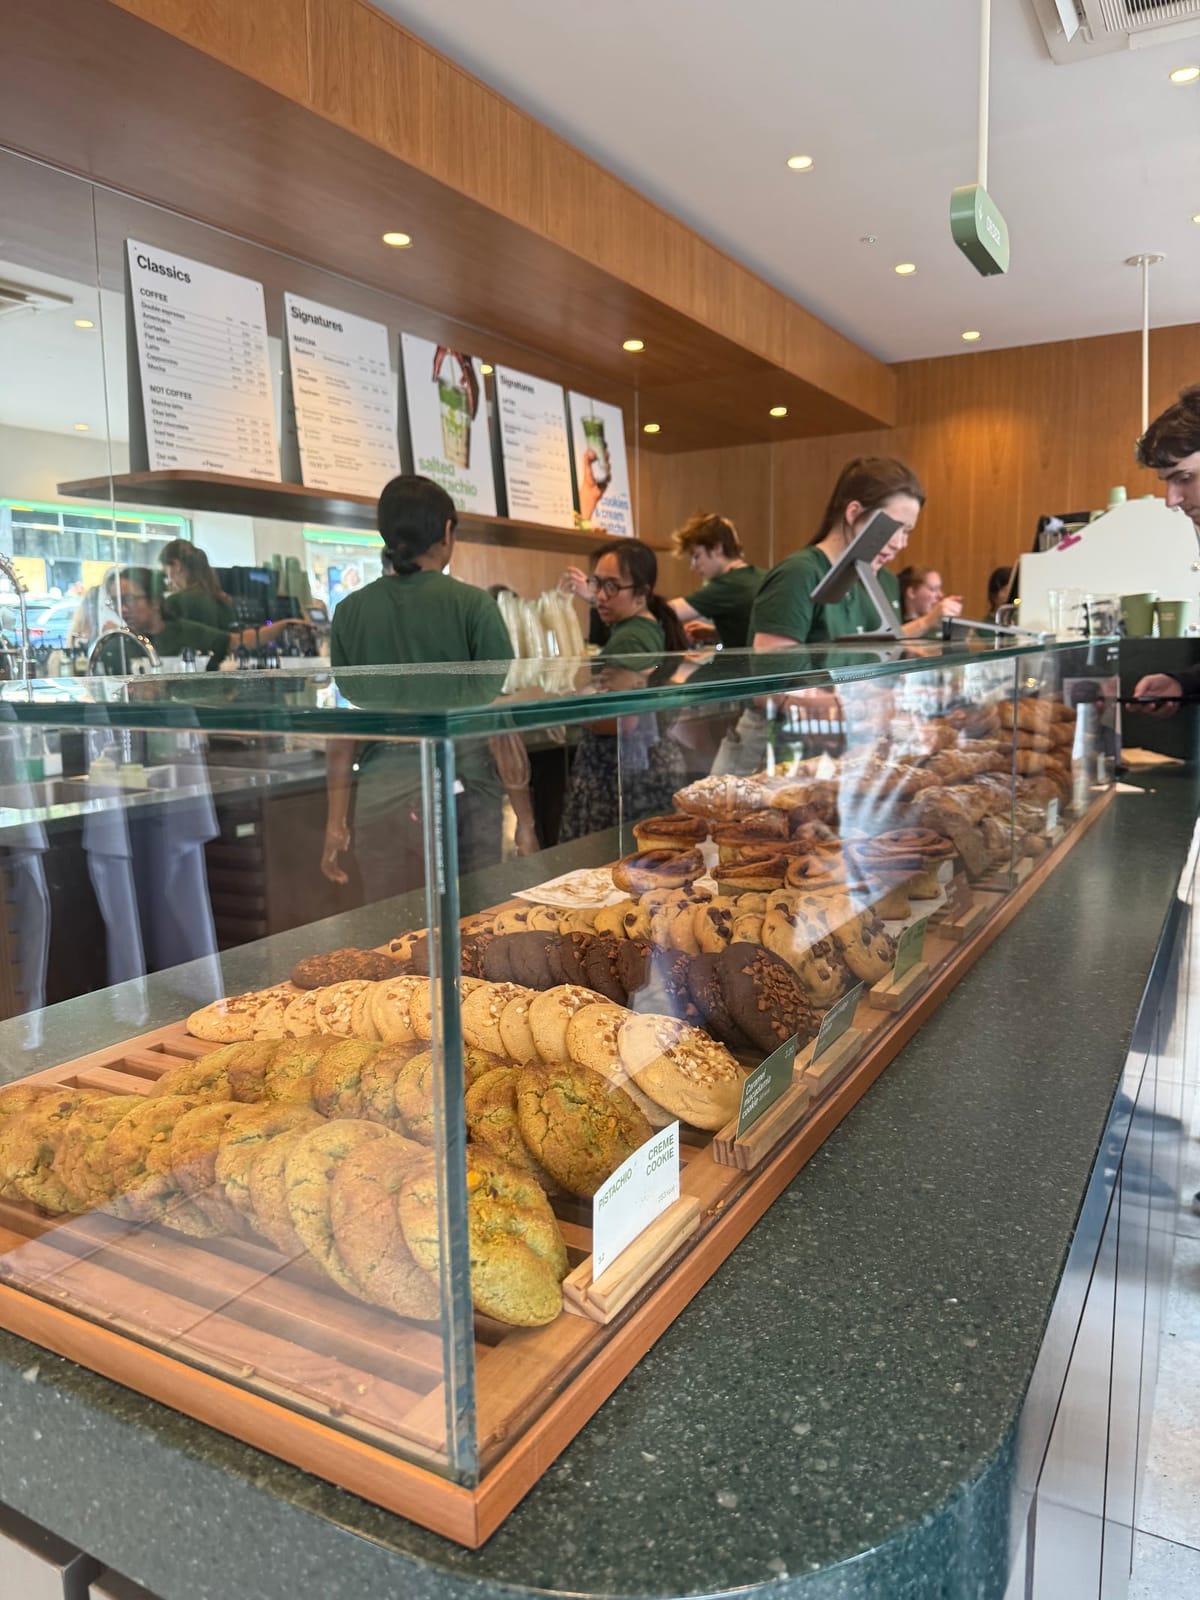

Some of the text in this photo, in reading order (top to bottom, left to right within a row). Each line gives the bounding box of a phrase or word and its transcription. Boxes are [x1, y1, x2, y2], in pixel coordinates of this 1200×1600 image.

[137, 255, 191, 284] Classics
[140, 288, 168, 302] COFFEE
[291, 306, 343, 332] Signatures
[149, 384, 192, 400] NOT COFFEE
[501, 376, 534, 394] Signatures
[598, 1168, 633, 1212] PISTACHIO
[648, 1134, 675, 1161] CREME
[646, 1147, 676, 1177] COOKIE
